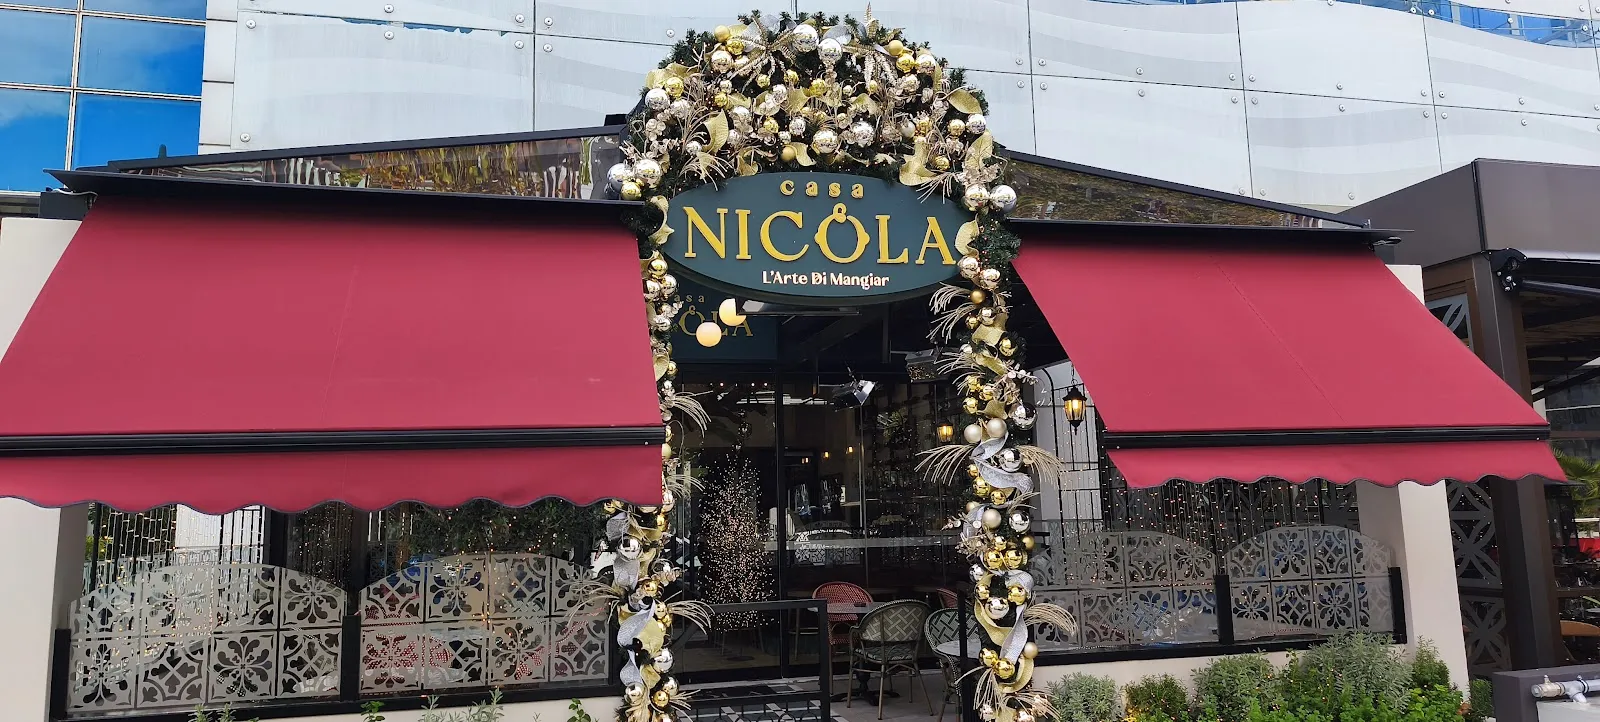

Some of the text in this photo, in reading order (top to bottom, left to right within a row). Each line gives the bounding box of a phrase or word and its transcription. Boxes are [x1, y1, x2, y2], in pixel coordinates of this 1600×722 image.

[779, 179, 864, 199] casa
[683, 202, 957, 266] NICOLA
[762, 270, 890, 290] L'Arte Di Mangiar
